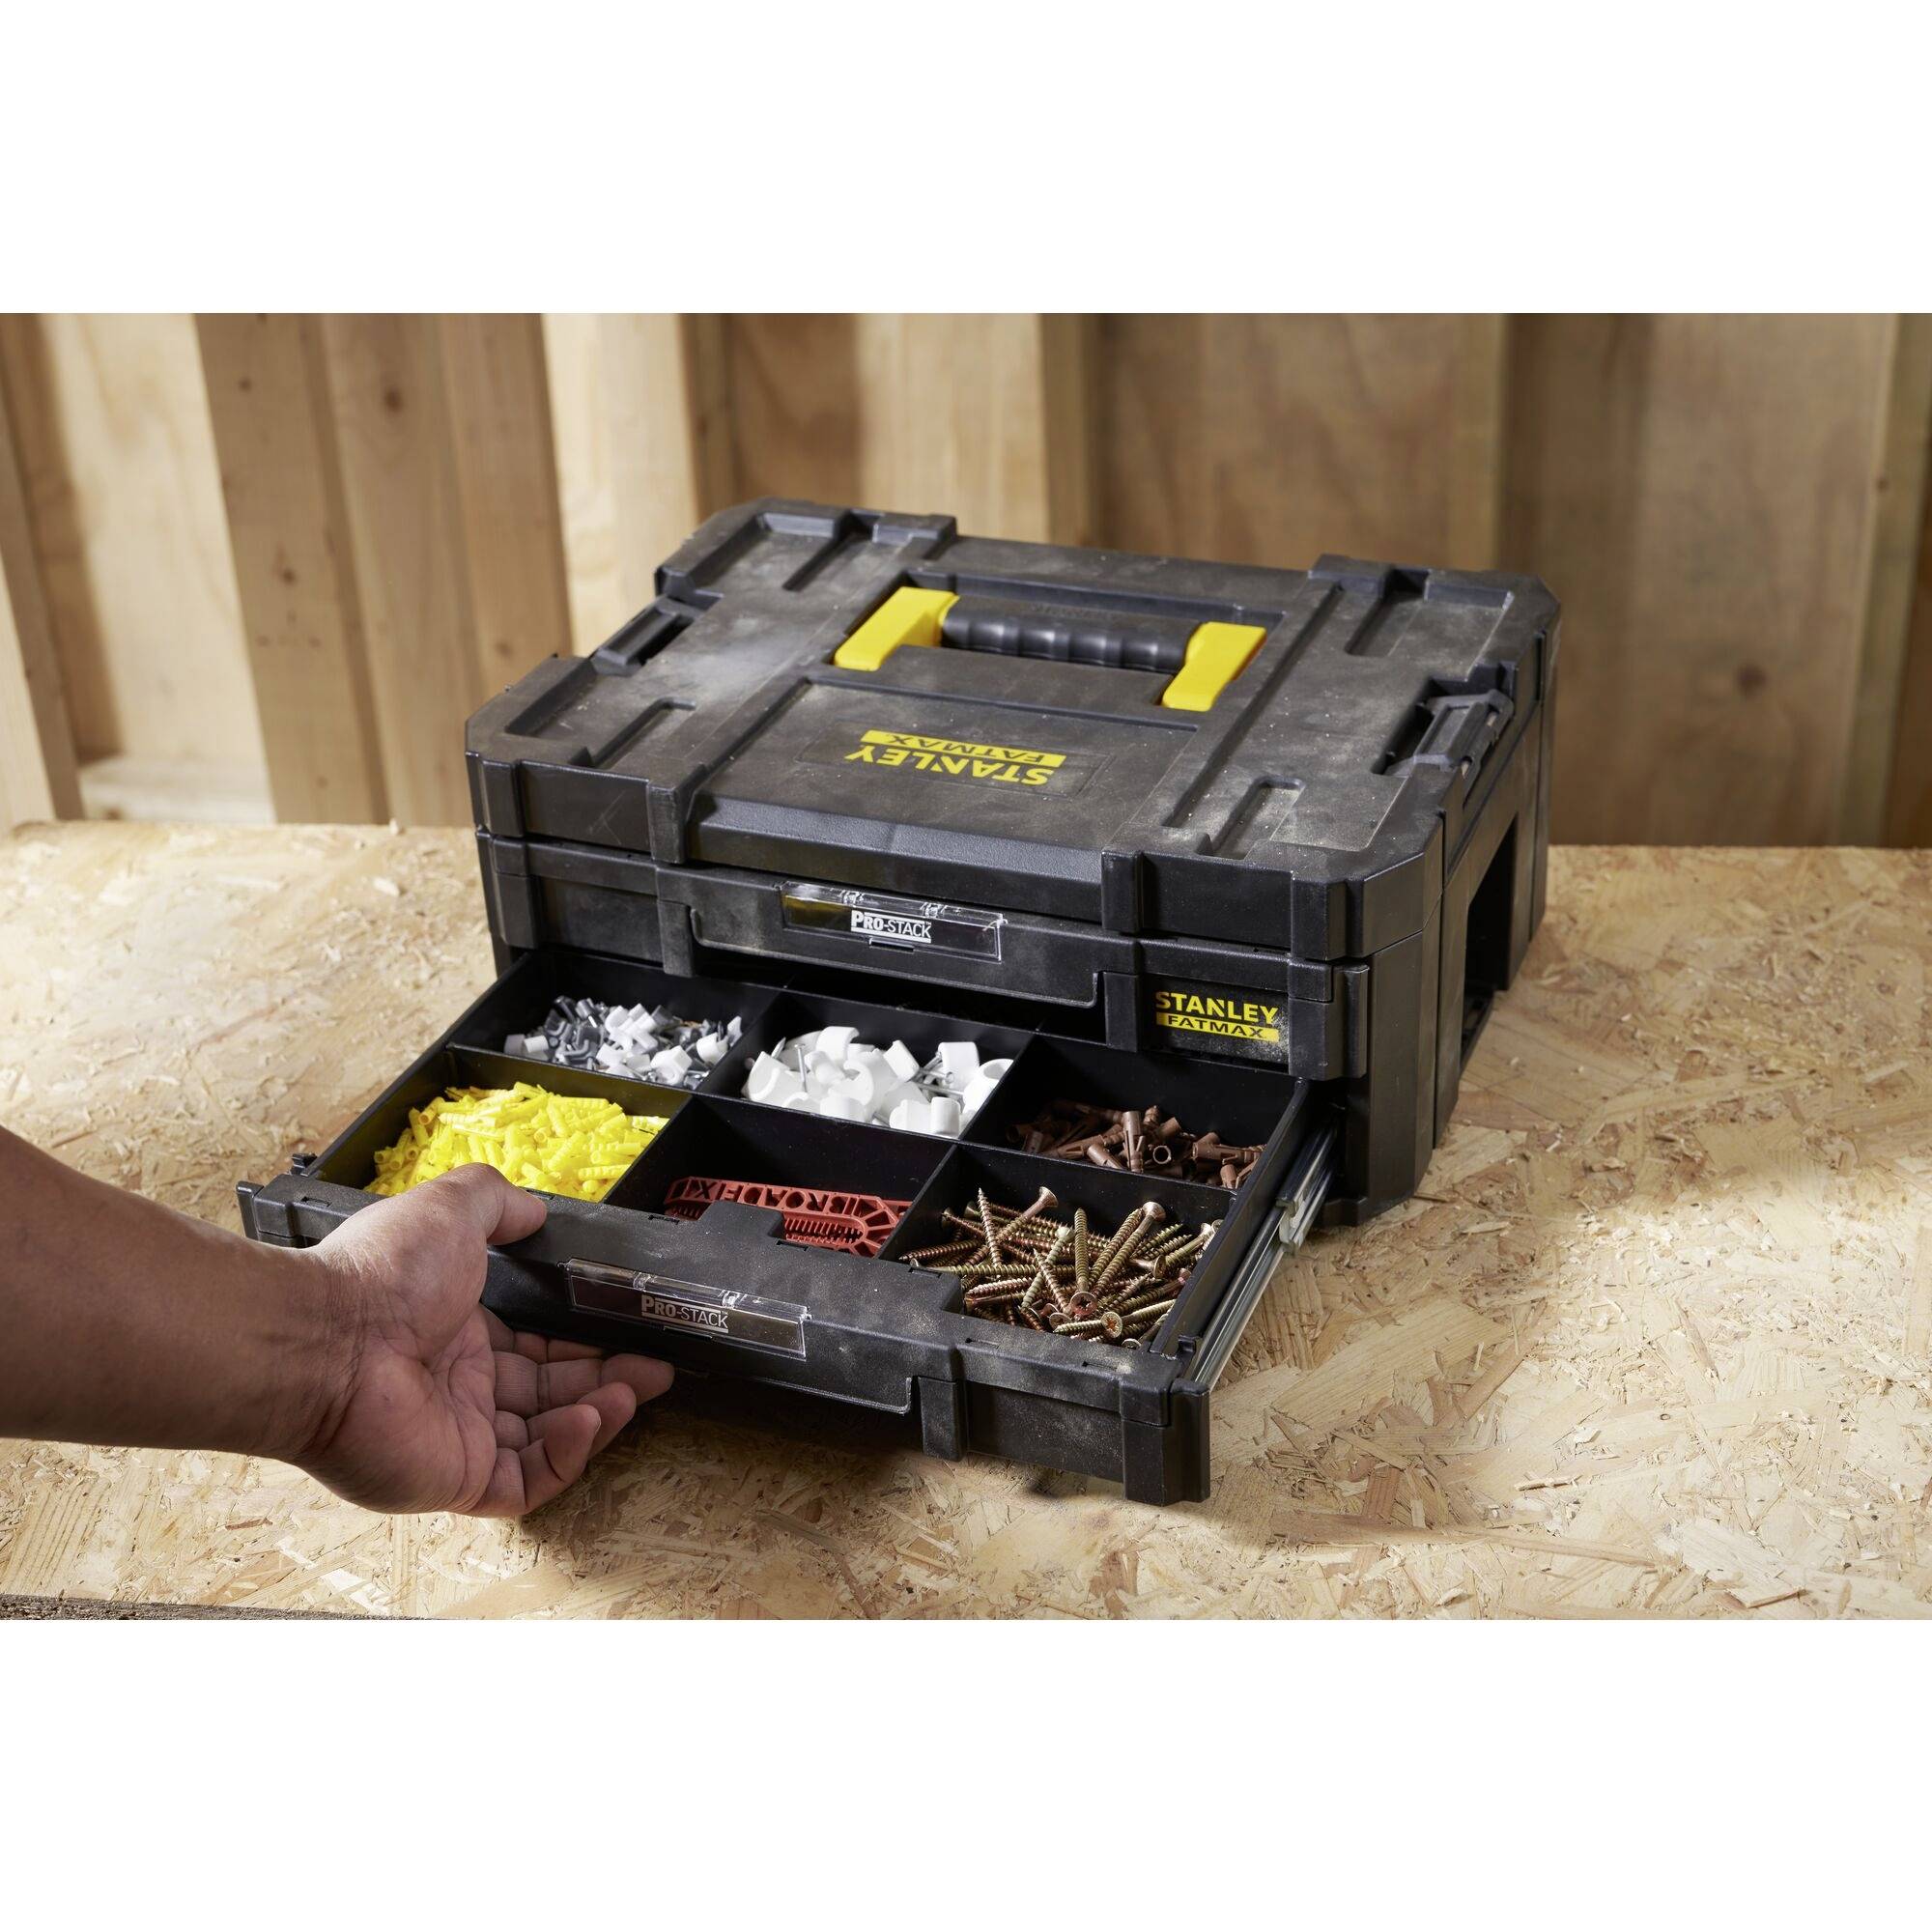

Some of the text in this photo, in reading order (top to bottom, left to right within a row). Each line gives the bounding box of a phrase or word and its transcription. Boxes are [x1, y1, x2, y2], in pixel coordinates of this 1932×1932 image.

[886, 734, 1045, 763] FATMAX
[843, 745, 1055, 785] STANLEY
[1155, 992, 1278, 1024] STANLEY
[1168, 1015, 1263, 1038] FATMAX
